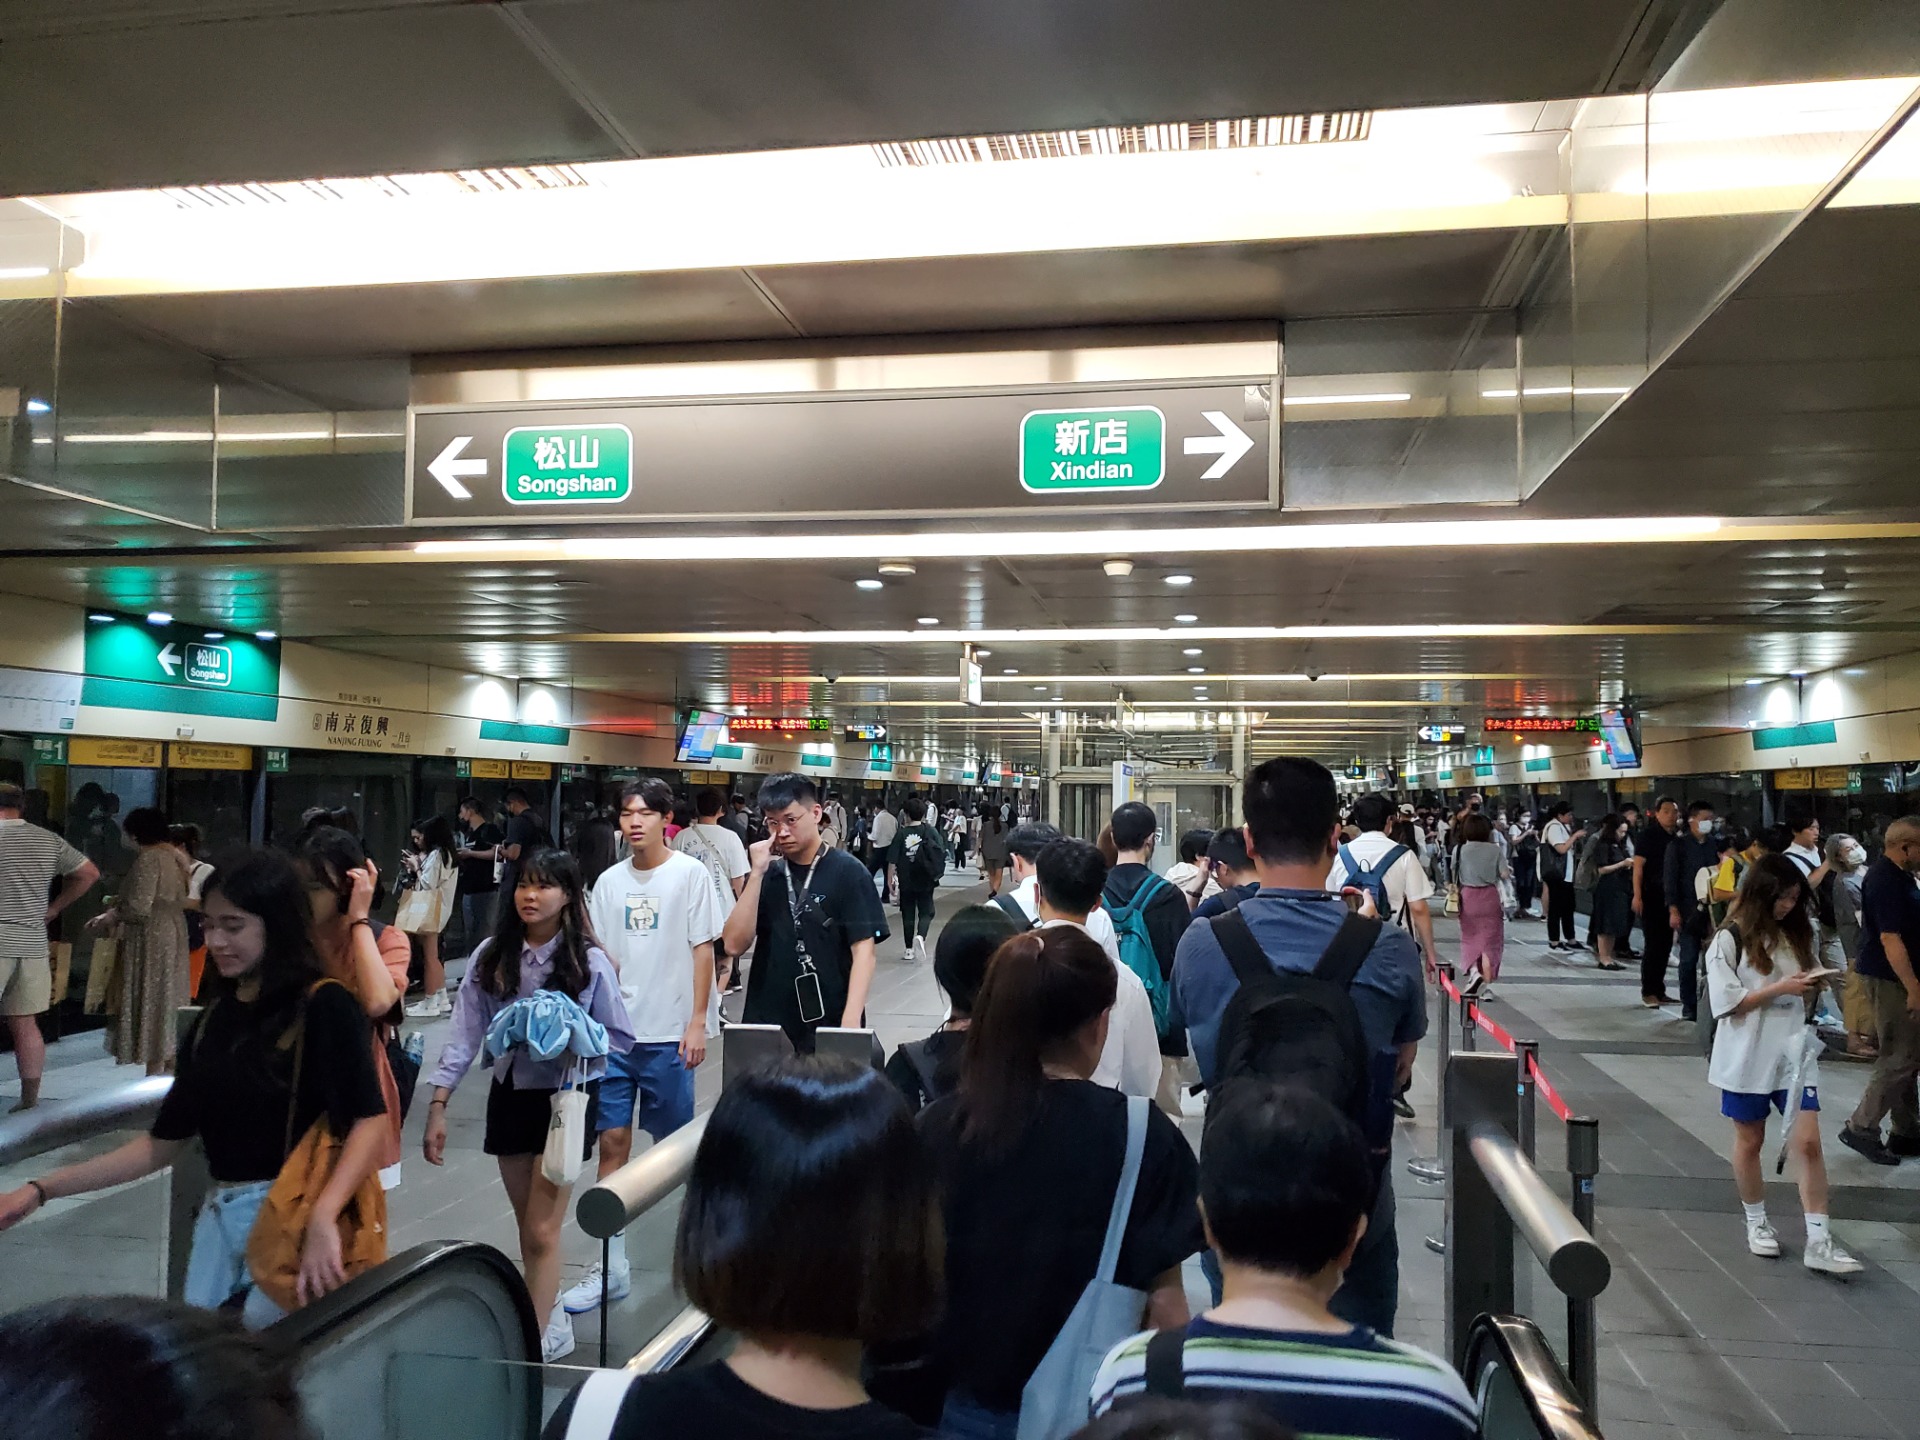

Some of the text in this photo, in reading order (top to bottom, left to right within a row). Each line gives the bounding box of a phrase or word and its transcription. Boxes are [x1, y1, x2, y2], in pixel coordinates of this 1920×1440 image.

[1054, 418, 1128, 456] 新店
[533, 435, 599, 470] 松山
[1049, 459, 1133, 481] Xindian
[517, 473, 617, 497] Songshan
[196, 648, 221, 669] 松山
[190, 667, 226, 681] Songshan
[325, 712, 389, 736] 南京復興
[54, 741, 62, 760] 1
[327, 736, 382, 748] NANJING FUXING
[281, 751, 286, 768] 1
[1855, 771, 1861, 787] 6
